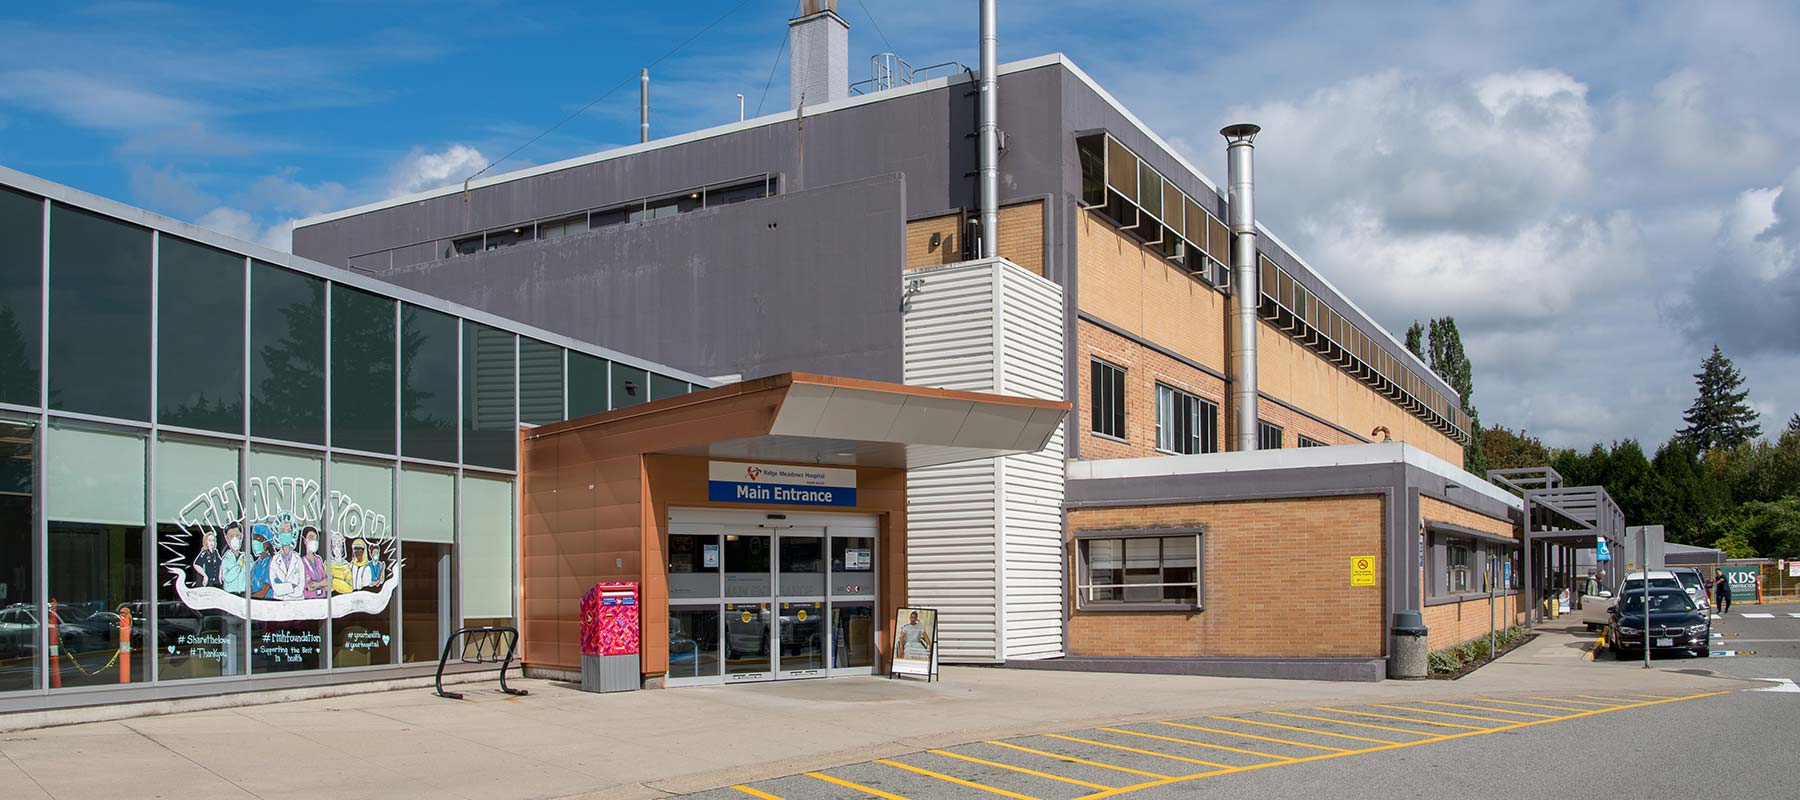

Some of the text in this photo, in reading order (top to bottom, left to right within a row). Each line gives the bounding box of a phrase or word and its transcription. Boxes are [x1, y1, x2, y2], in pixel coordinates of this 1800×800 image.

[779, 470, 804, 478] Meadows
[805, 472, 825, 480] Hospital
[736, 484, 833, 503] Main Entrance
[180, 476, 386, 546] THANK YOU
[1728, 571, 1756, 584] KDS
